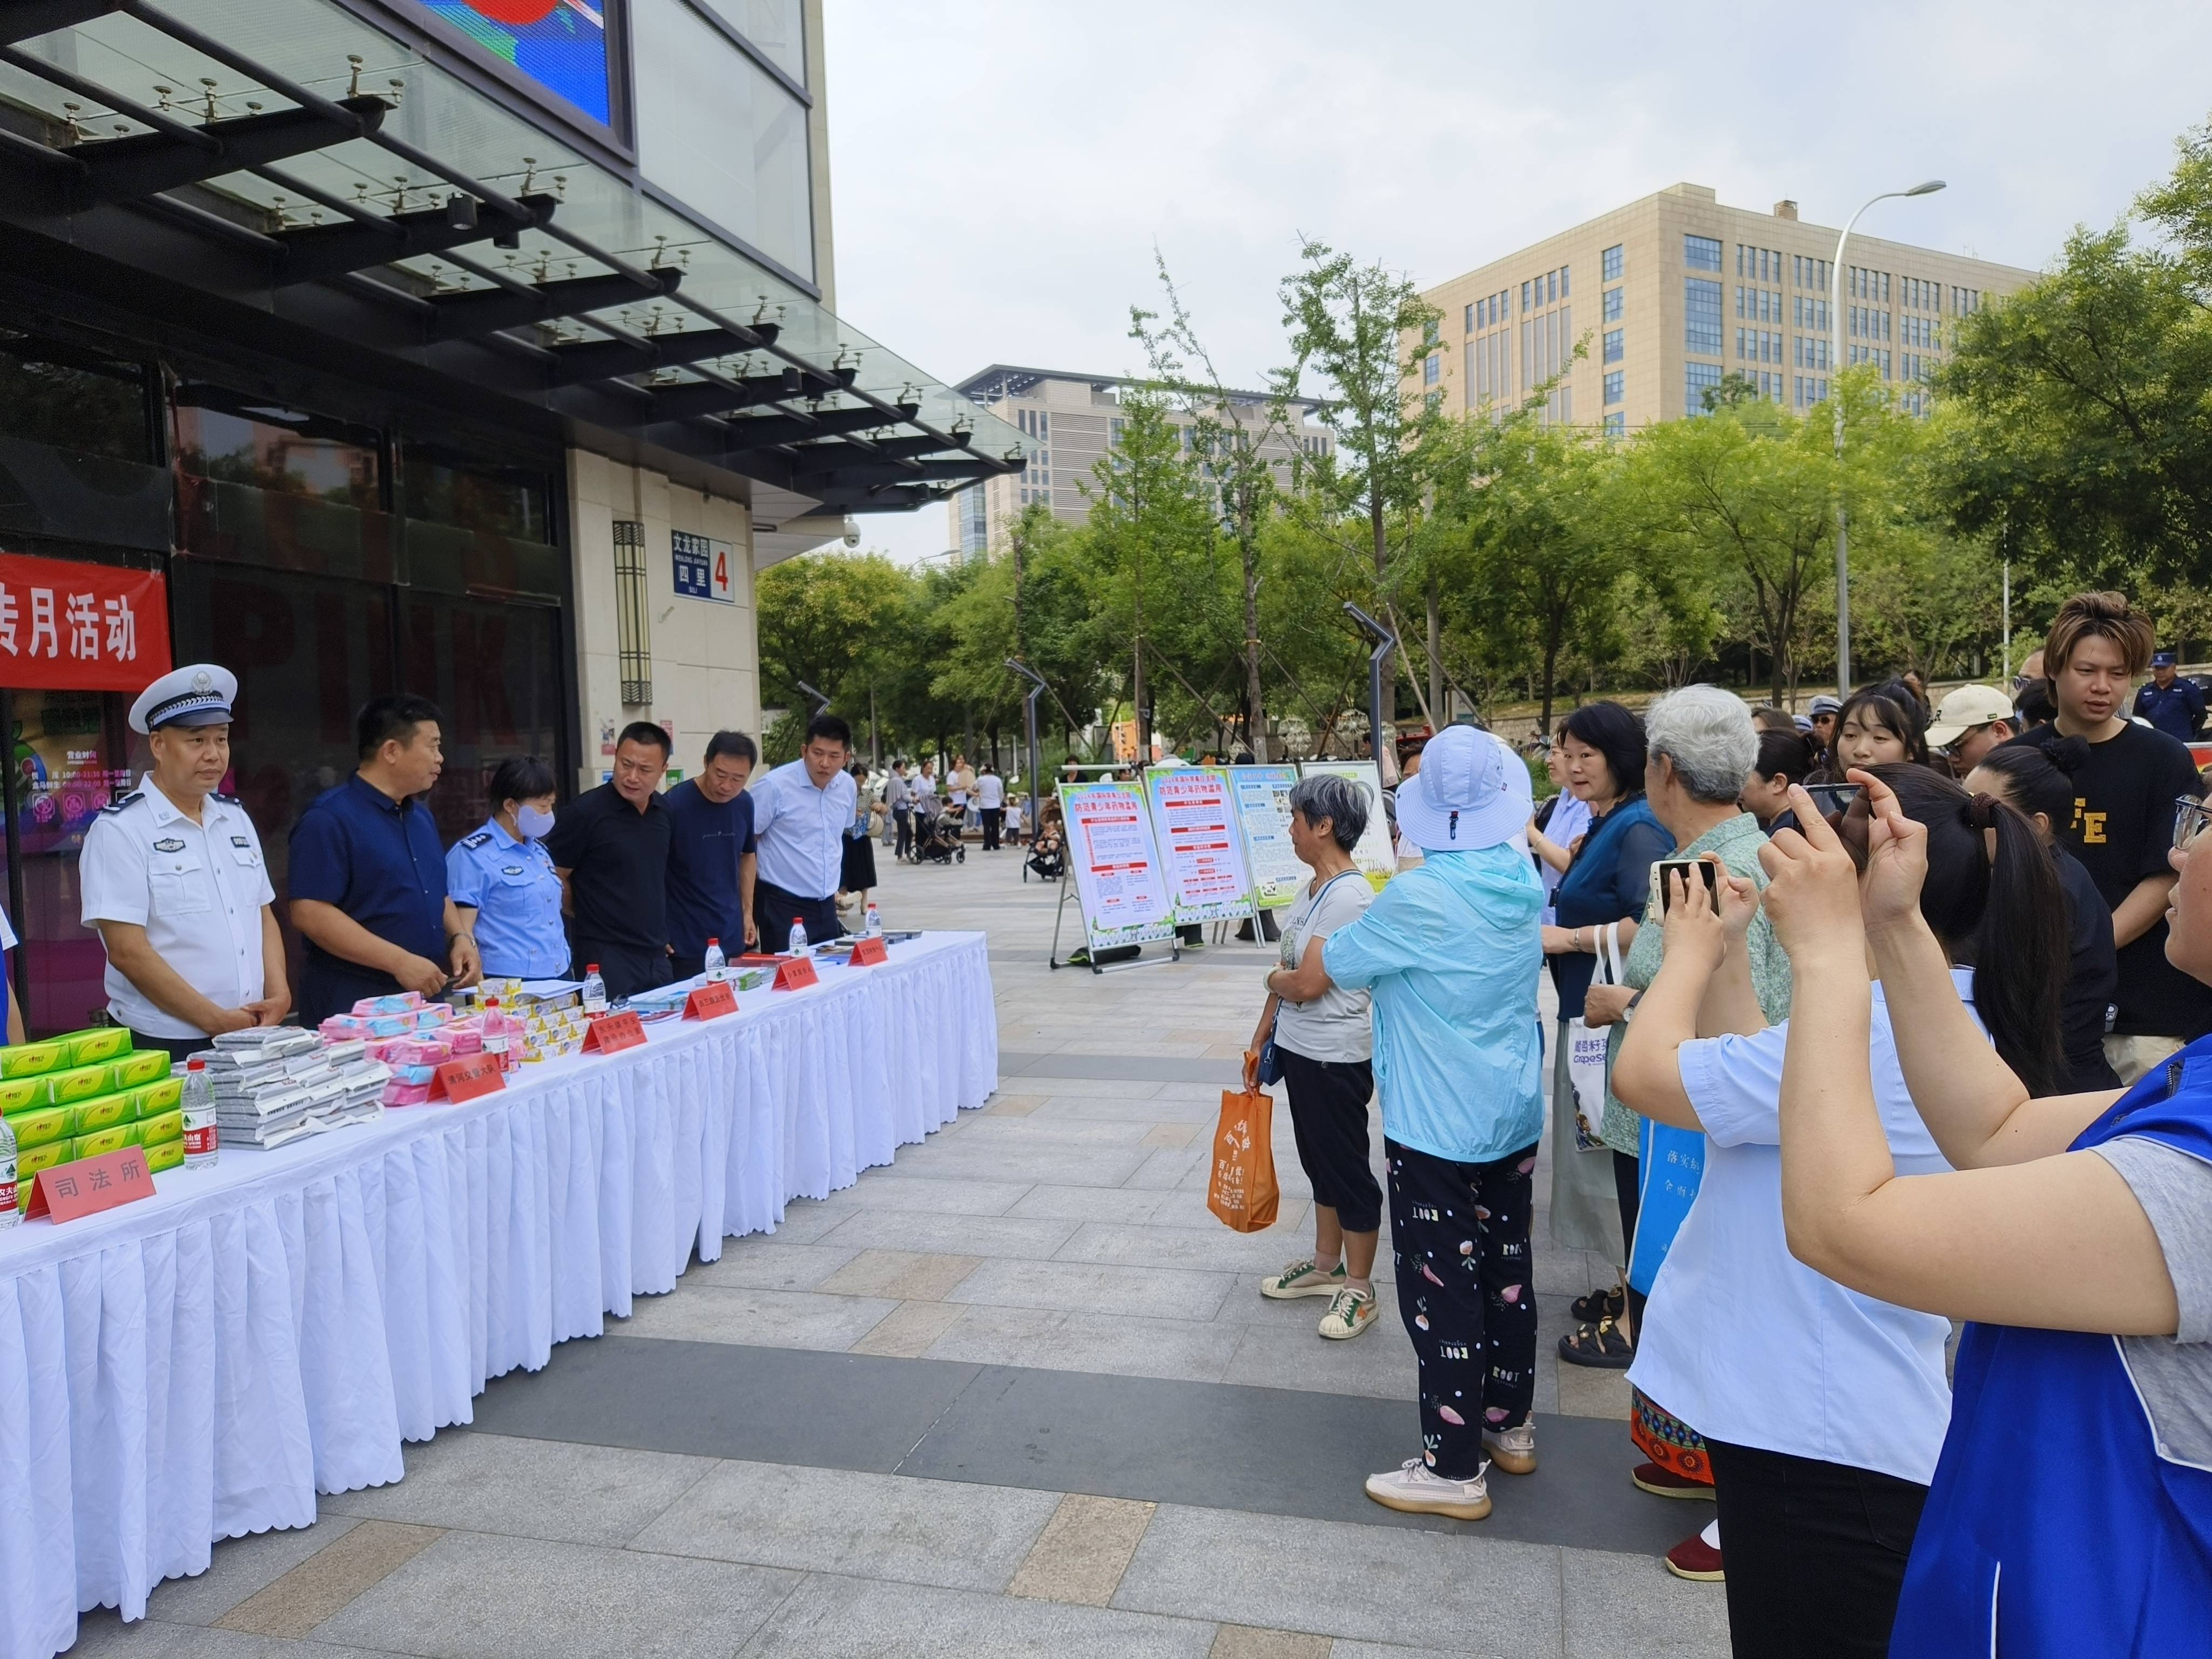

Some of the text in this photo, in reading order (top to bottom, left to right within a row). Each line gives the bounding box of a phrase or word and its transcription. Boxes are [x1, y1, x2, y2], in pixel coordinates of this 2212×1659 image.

[673, 532, 709, 557] 文龙家园
[679, 564, 706, 587] 四里
[716, 551, 728, 591] 4
[55, 1159, 141, 1198] 司法所
